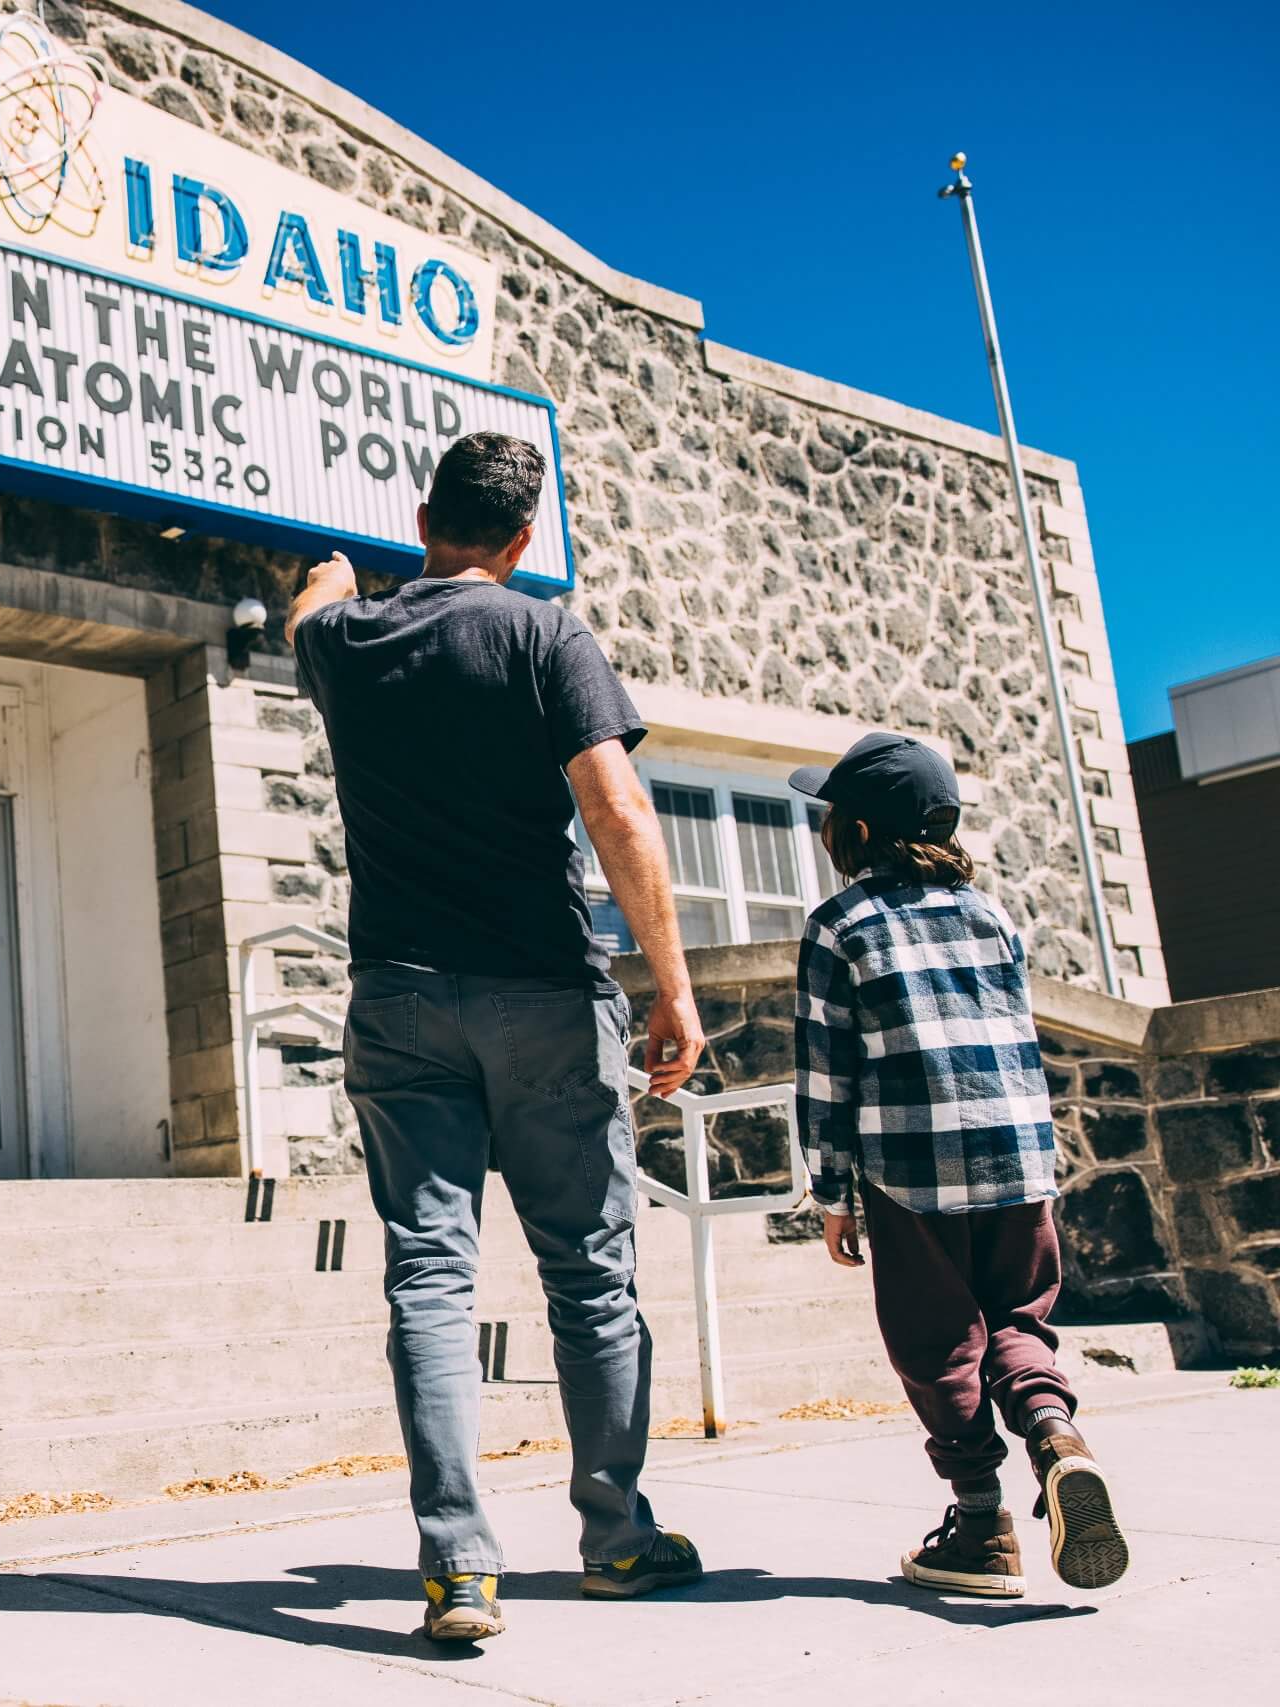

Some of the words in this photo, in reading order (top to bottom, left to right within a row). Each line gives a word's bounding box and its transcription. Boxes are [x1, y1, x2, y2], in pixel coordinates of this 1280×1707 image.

[124, 155, 480, 351] IDAHO
[84, 291, 215, 375] THE
[248, 337, 462, 439] WORLD
[150, 439, 271, 497] 5320
